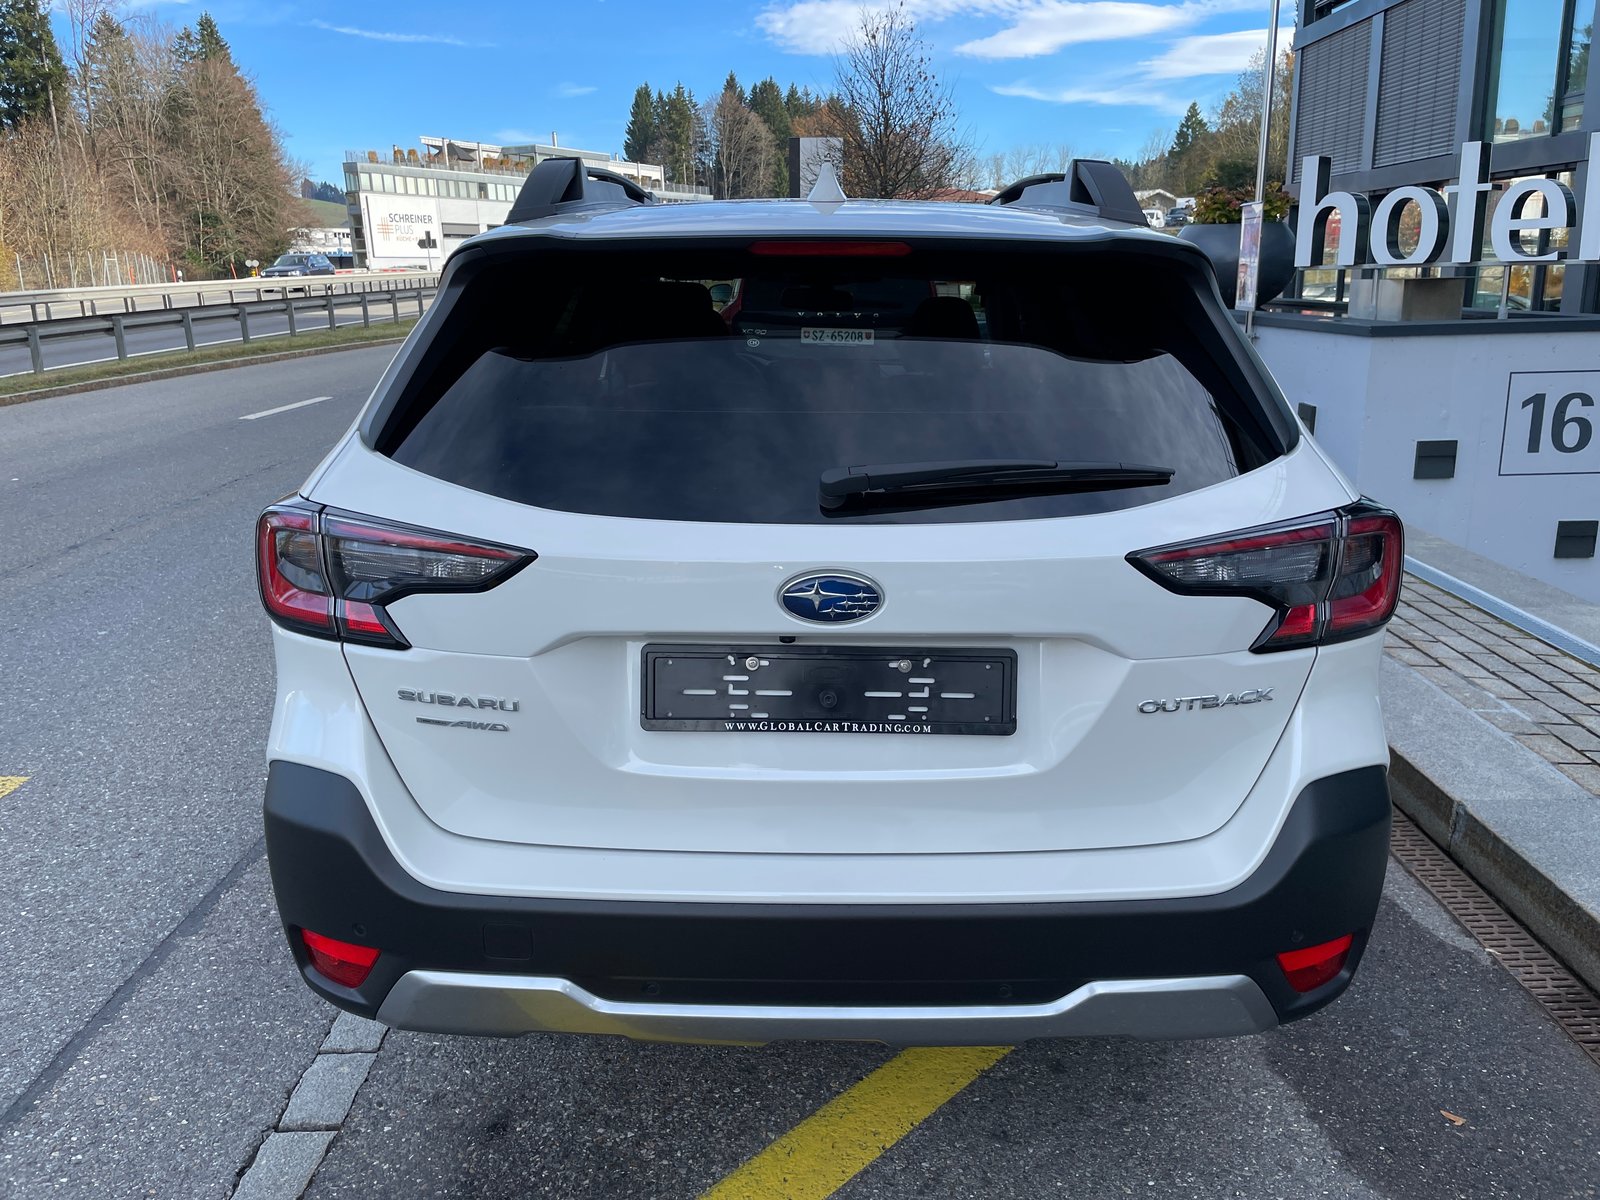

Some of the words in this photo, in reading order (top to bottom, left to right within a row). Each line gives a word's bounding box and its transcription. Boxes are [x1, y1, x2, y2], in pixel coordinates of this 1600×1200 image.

[1294, 132, 1600, 267] hotel
[388, 213, 433, 223] SCHREINER
[395, 225, 414, 235] PLUS
[1521, 391, 1595, 454] 16
[397, 688, 520, 712] SUBARU
[1137, 687, 1274, 714] OUTBACK
[450, 720, 510, 732] AWD
